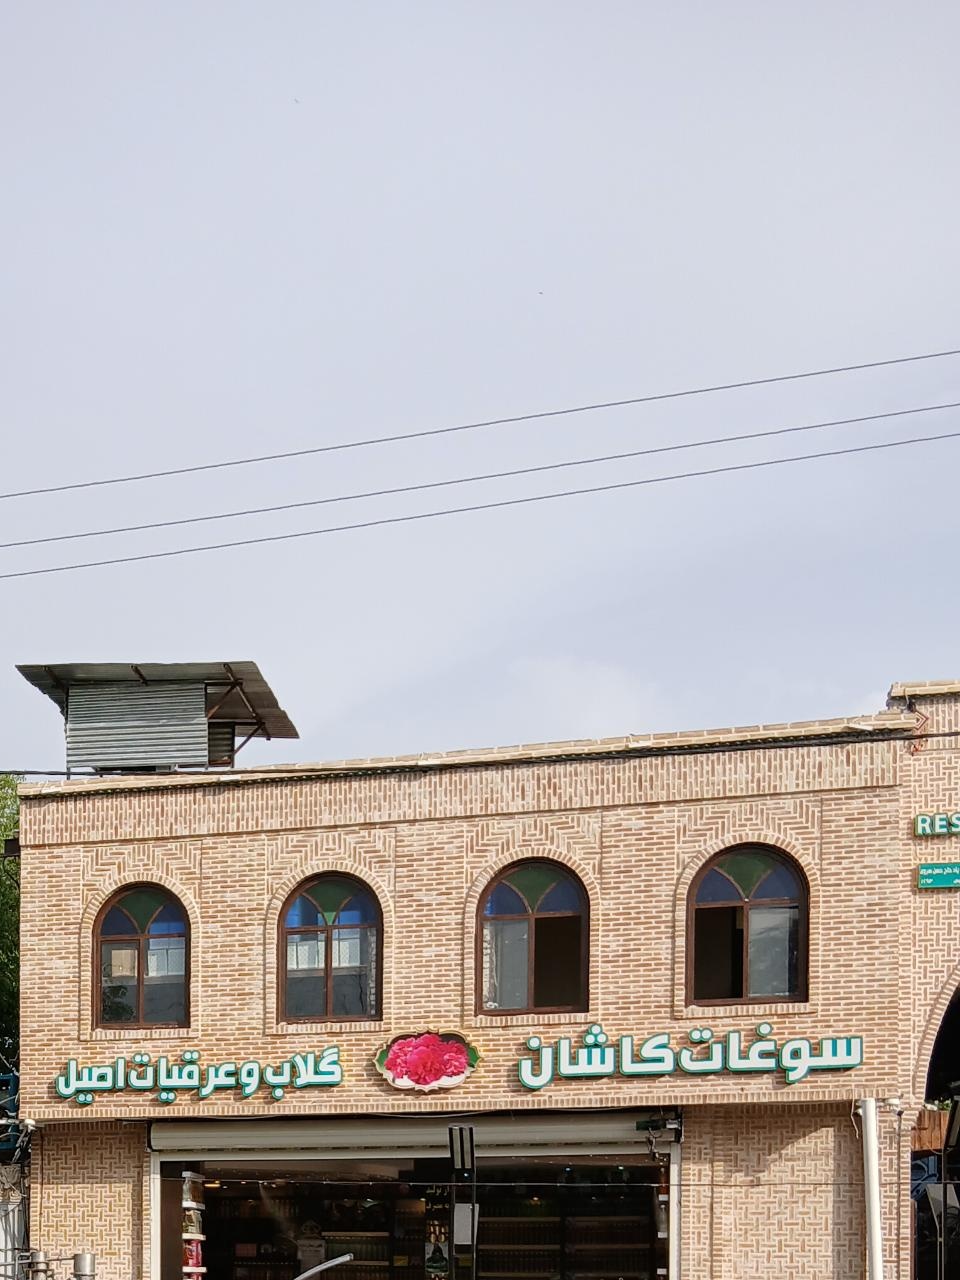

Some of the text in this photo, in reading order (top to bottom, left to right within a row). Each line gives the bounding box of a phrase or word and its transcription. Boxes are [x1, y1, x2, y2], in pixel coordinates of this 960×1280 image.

[55, 1057, 127, 1105] اصیل
[127, 1050, 237, 1104] عرقیات
[264, 1045, 344, 1101] گلاب
[518, 1022, 863, 1090] سوغات کاشان
